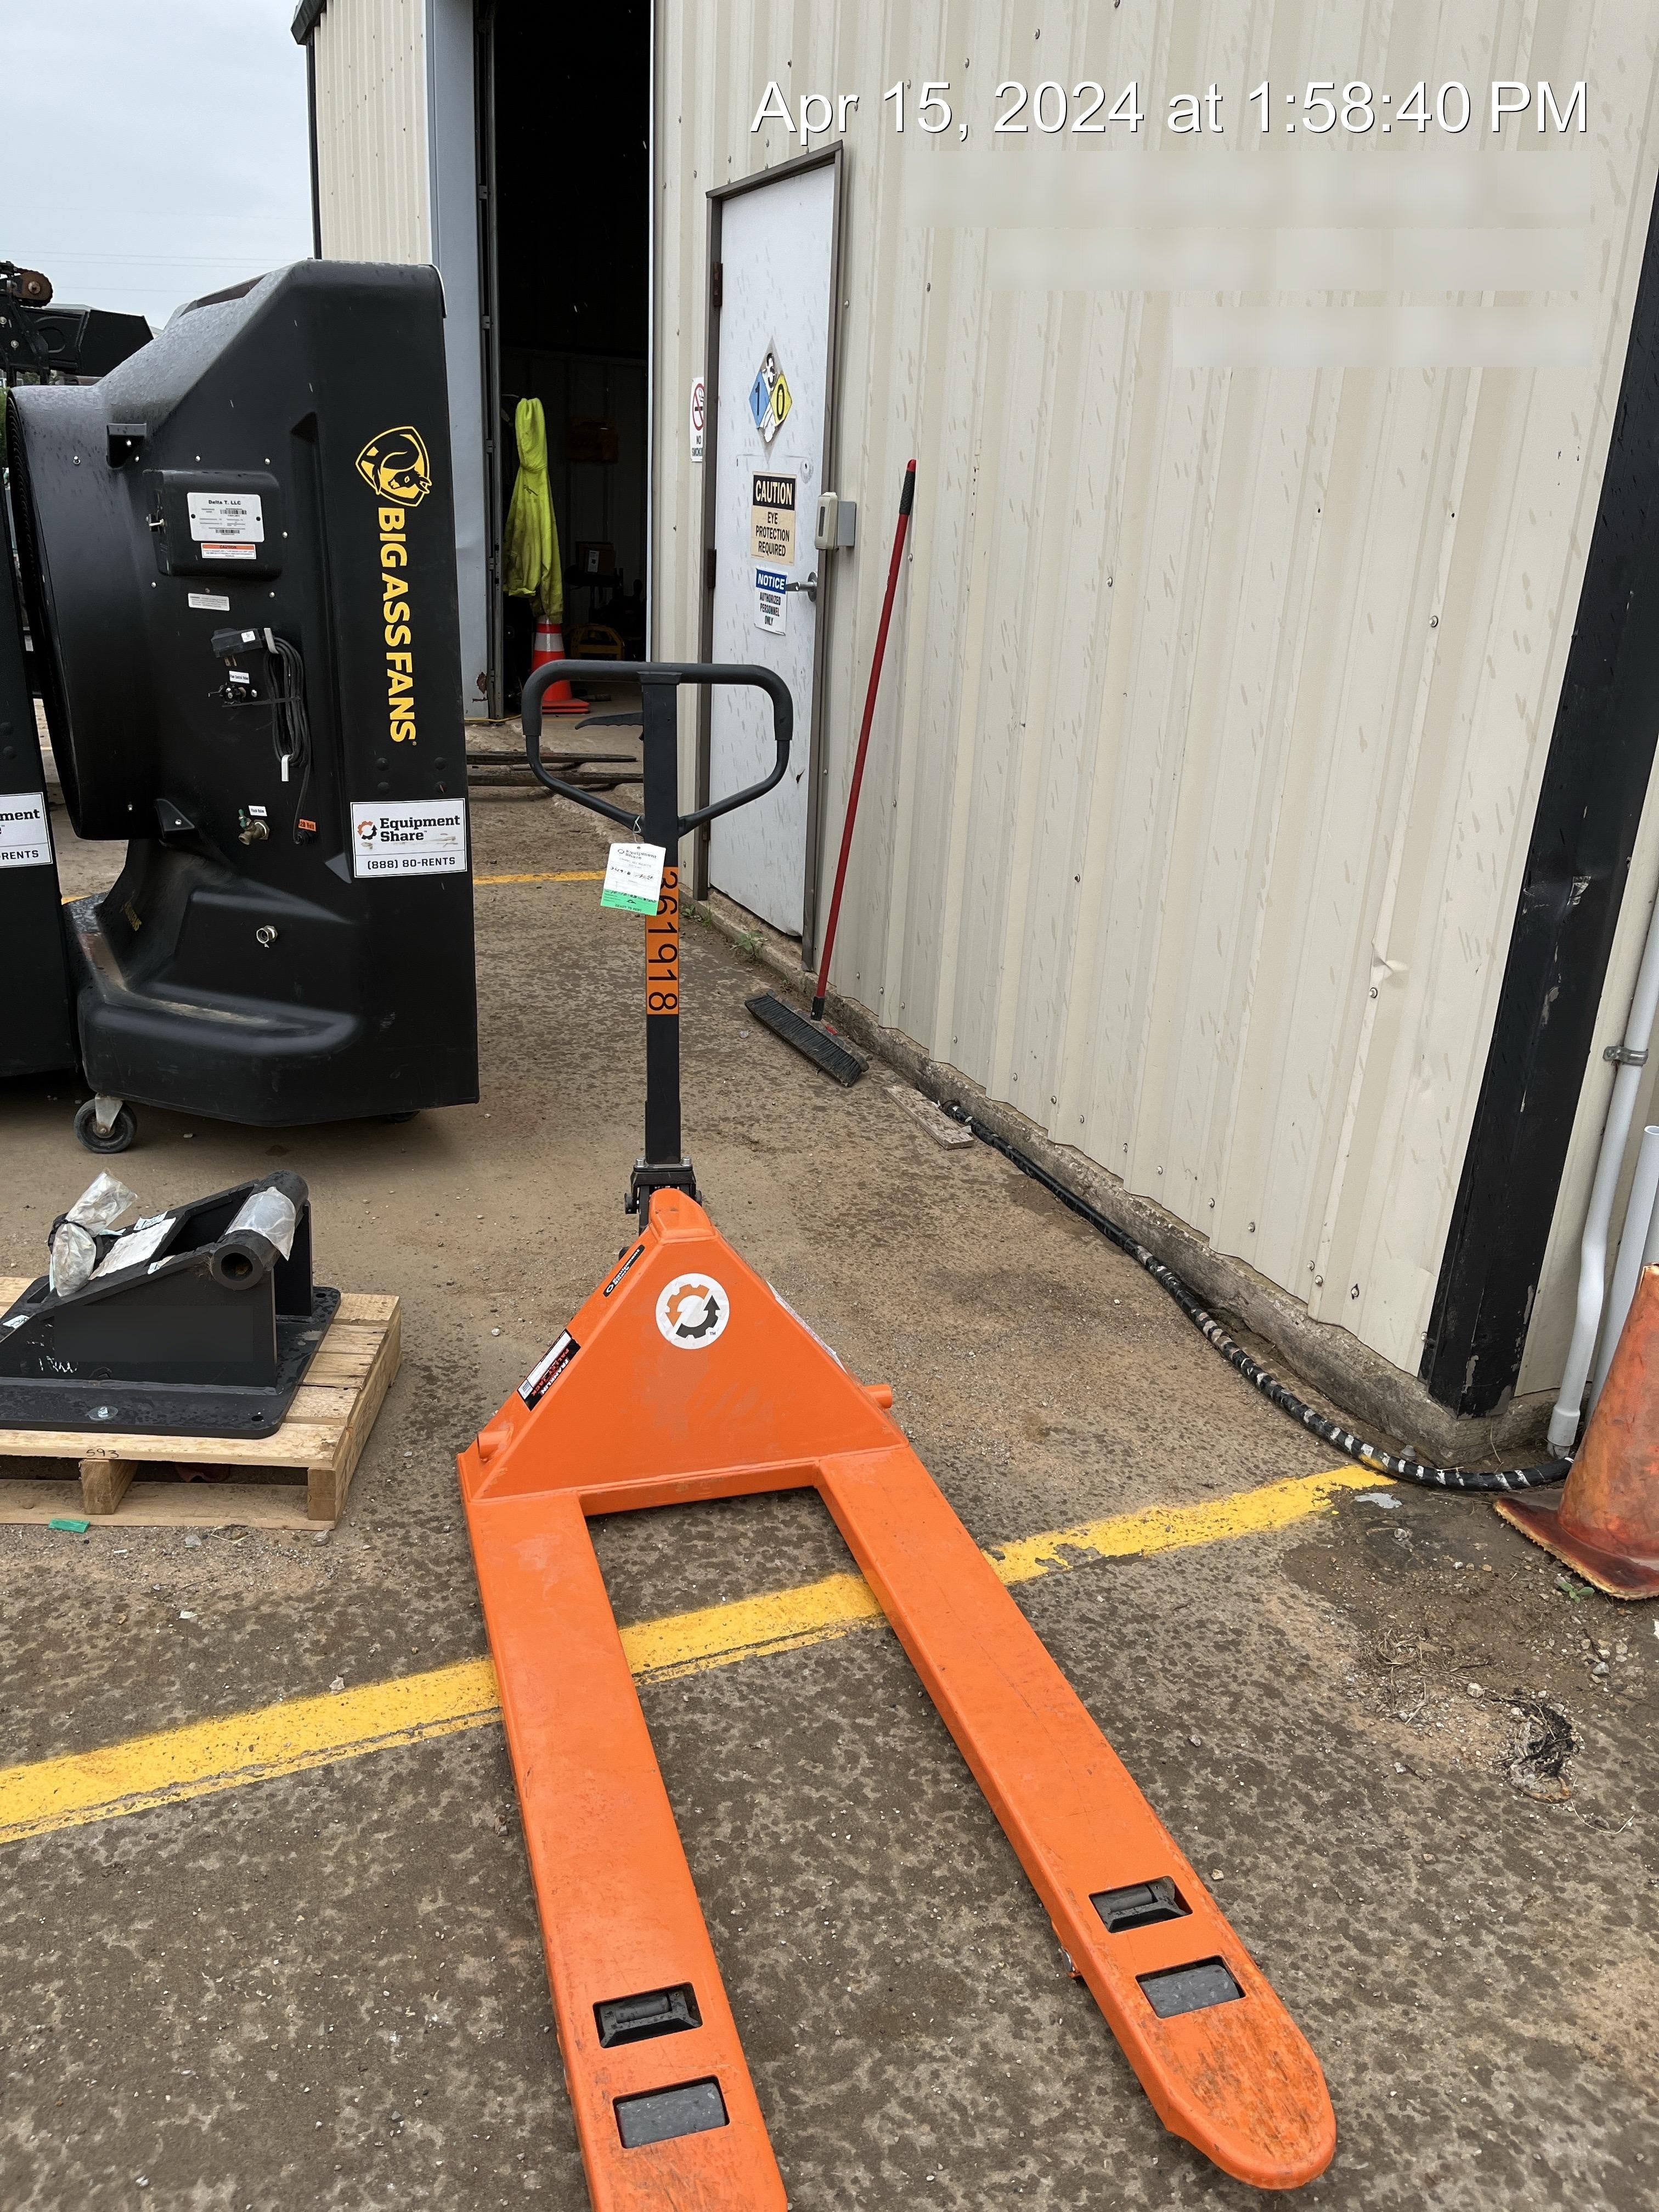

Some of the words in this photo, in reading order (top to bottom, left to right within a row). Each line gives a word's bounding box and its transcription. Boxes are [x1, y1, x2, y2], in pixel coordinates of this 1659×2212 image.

[755, 381, 761, 416] 1
[776, 383, 785, 421] 0
[696, 436, 702, 445] NO
[755, 480, 793, 505] CAUTION
[768, 511, 778, 524] EYE
[378, 507, 408, 568] BIG
[755, 525, 790, 542] PROTECTION
[758, 540, 786, 556] REQUIRED
[758, 573, 785, 590] NOTICE
[760, 591, 781, 606] AUTHORIZED
[381, 572, 411, 647] ASS
[760, 603, 780, 617] PERSONNEL
[764, 615, 774, 626] ONLY
[386, 652, 416, 742] FANS
[0, 809, 41, 822] ment
[380, 815, 460, 831] Equipment
[368, 859, 398, 870] (888)
[402, 856, 456, 868] 80-RENTS
[612, 1249, 640, 1283] Equipment
[540, 1357, 569, 1395] FRANKLIN
[86, 1448, 120, 1459] 593
